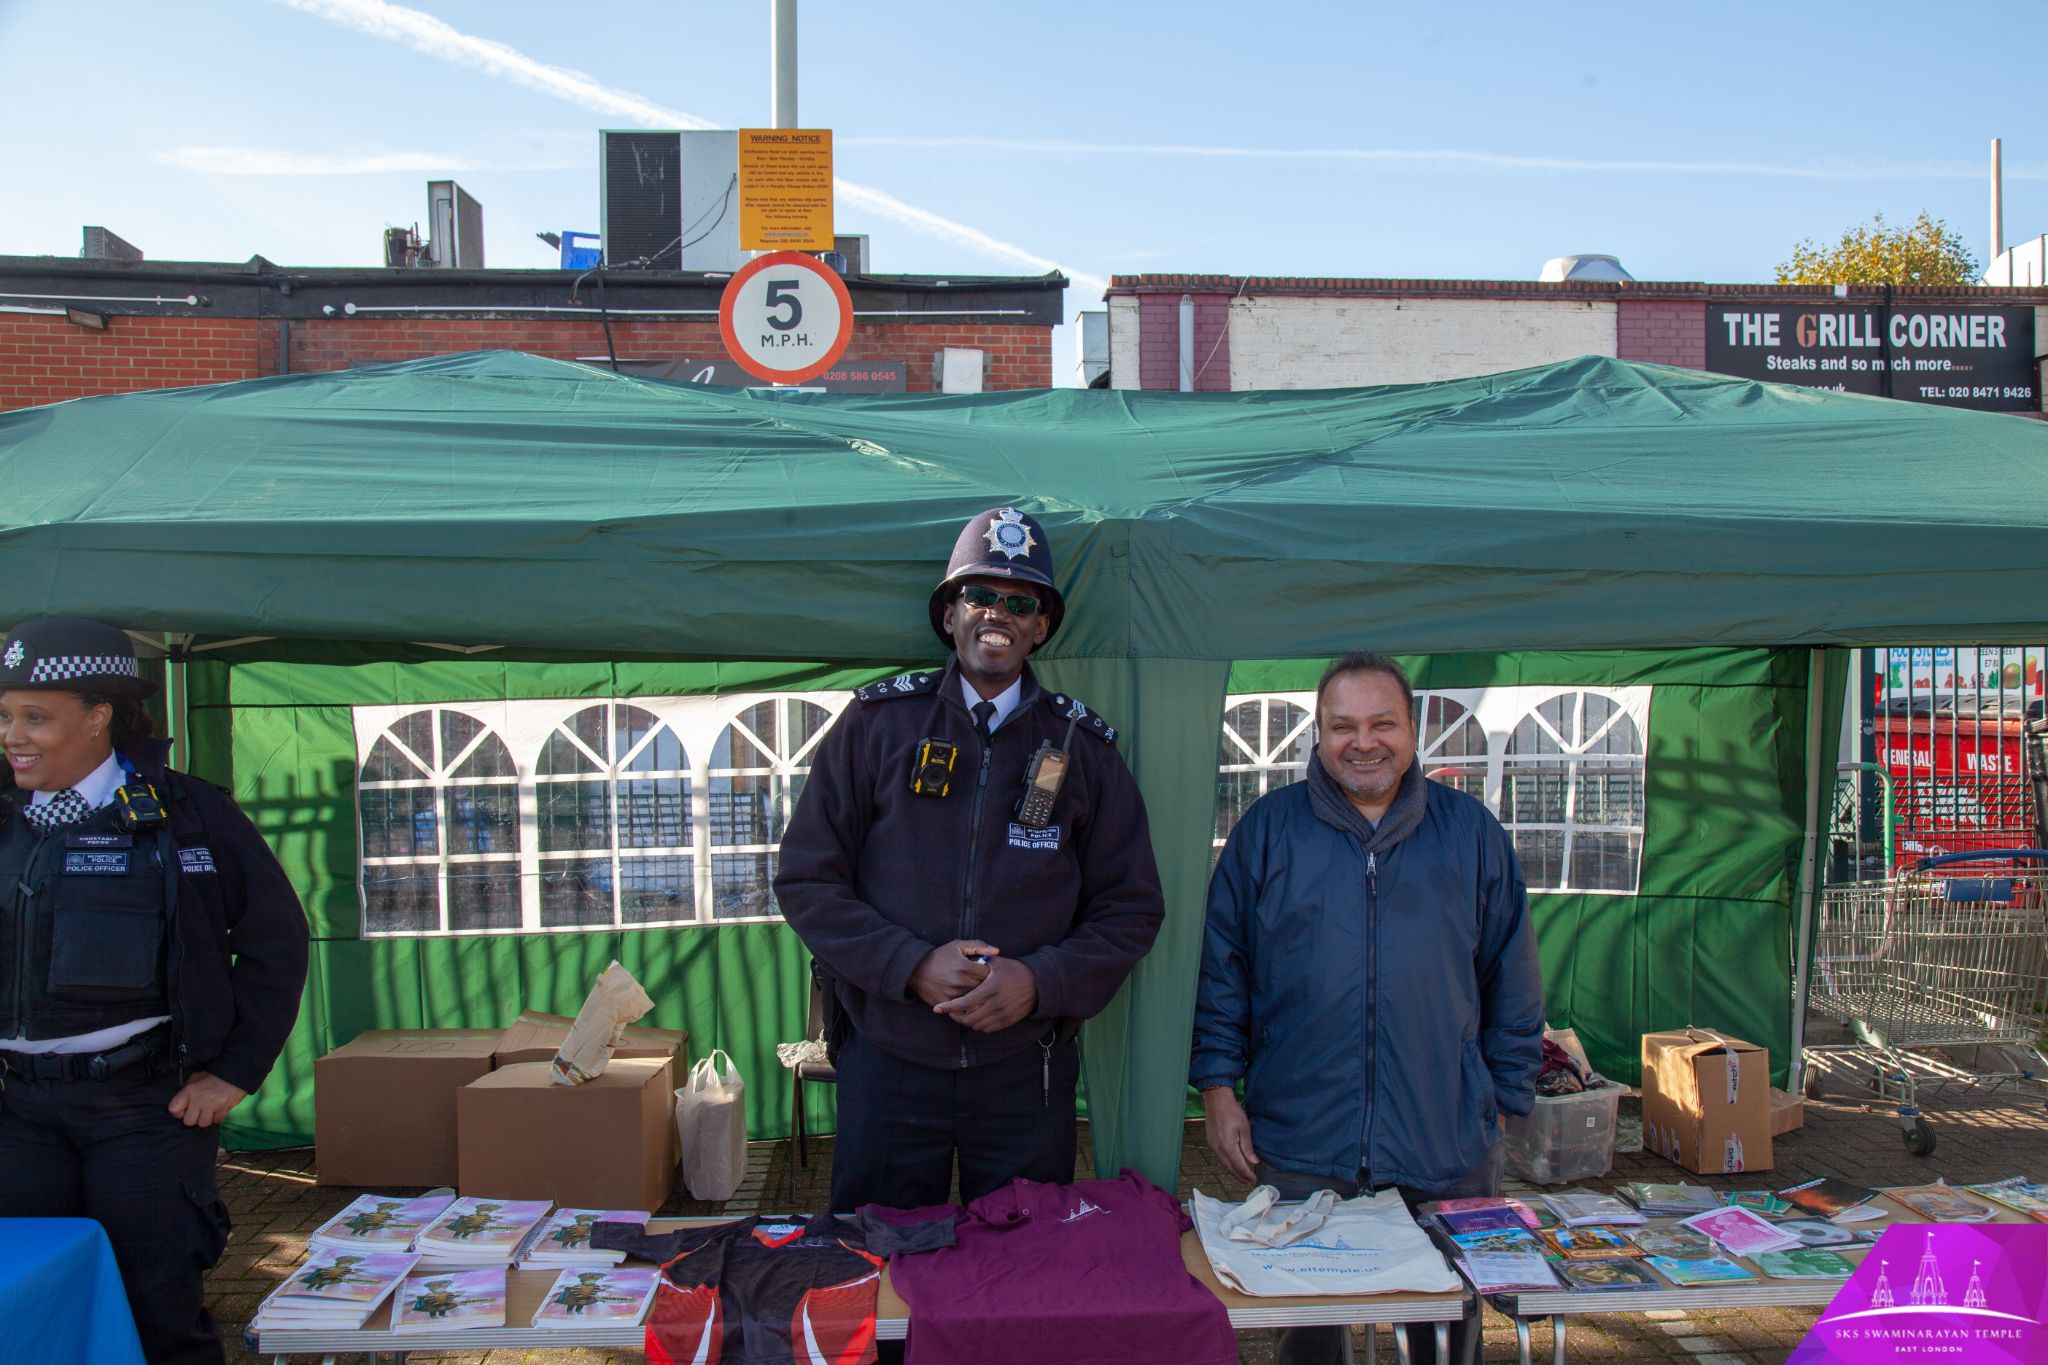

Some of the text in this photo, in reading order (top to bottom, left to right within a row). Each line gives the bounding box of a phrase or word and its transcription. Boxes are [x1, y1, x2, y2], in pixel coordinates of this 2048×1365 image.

[766, 280, 802, 331] 5
[1723, 313, 2007, 347] THE GRILL CORNER
[761, 334, 813, 347] M.P.H.
[1766, 355, 1816, 370] Steaks
[1820, 356, 1847, 370] and
[1851, 359, 1867, 370] so
[1871, 356, 1911, 370] mch
[823, 371, 896, 380] 0208 586 0545
[1919, 387, 2032, 398] TEL: 020 8471 9426
[1009, 838, 1058, 850] POLICE OFFICER
